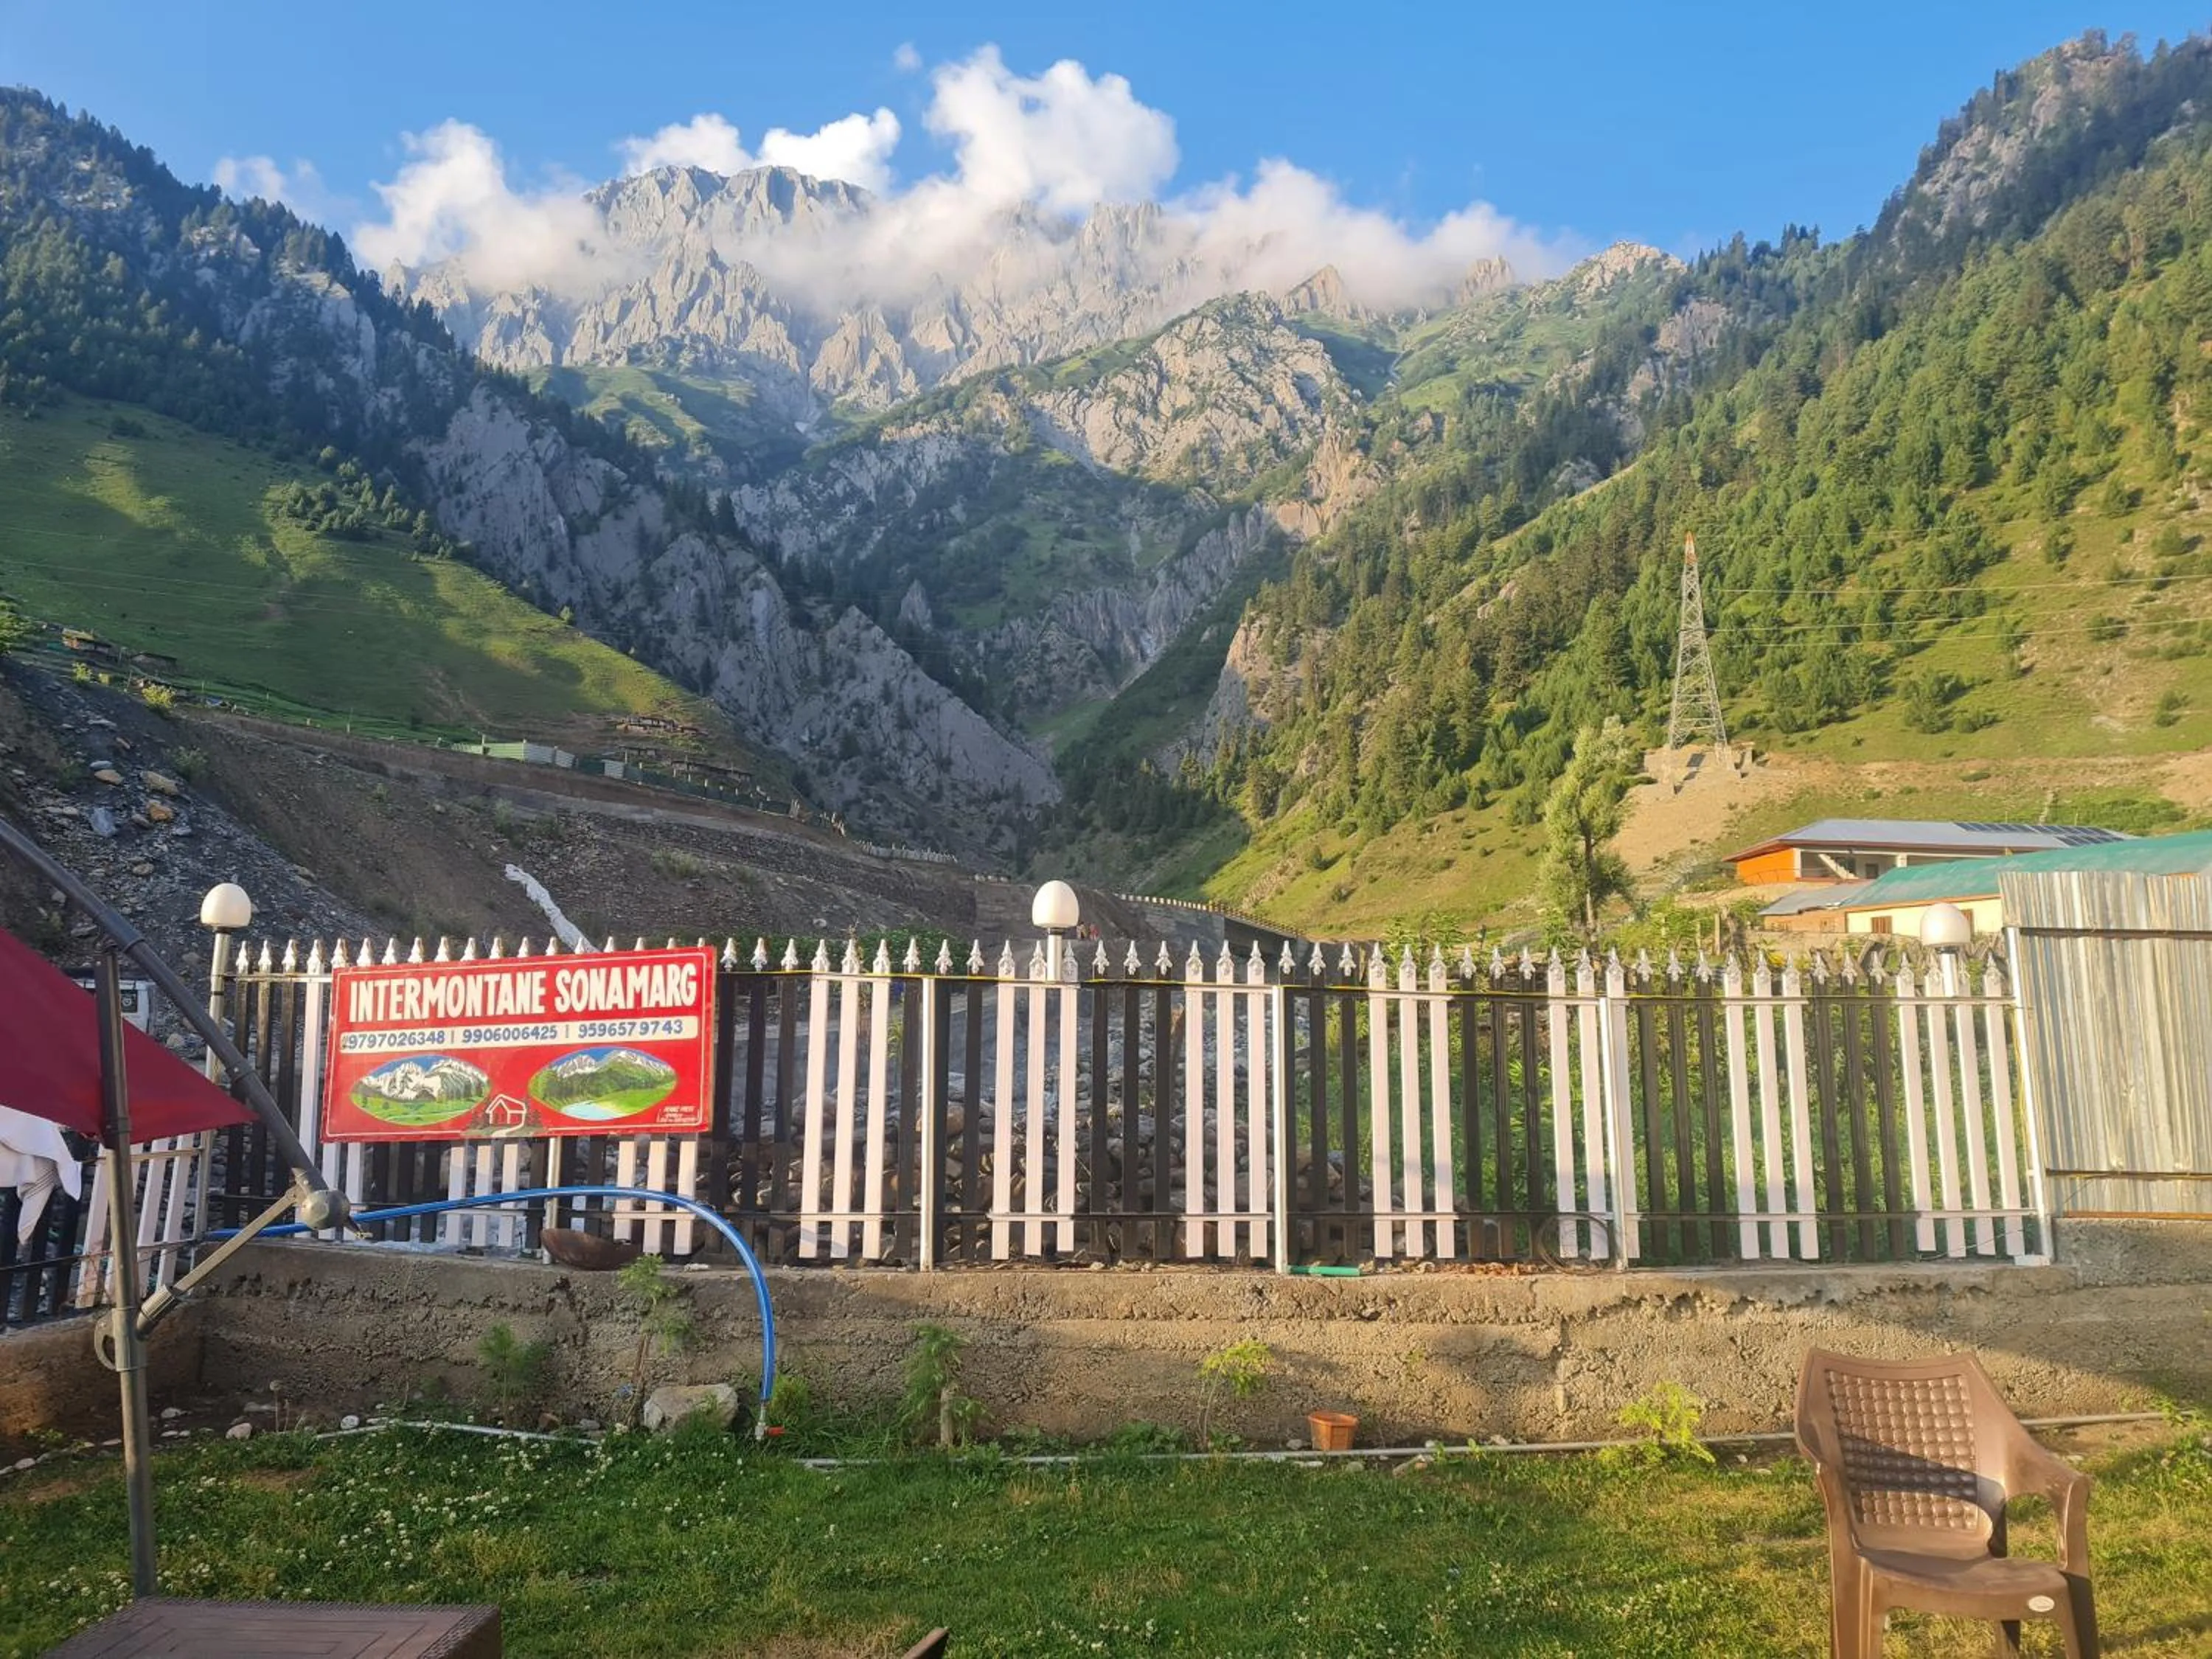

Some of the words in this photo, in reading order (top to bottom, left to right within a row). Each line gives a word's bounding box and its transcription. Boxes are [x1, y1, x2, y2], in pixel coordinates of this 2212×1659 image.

[349, 971, 546, 1022] INTERMONTANE
[555, 963, 696, 1012] SONAMARG
[462, 1025, 558, 1043] 9906006425
